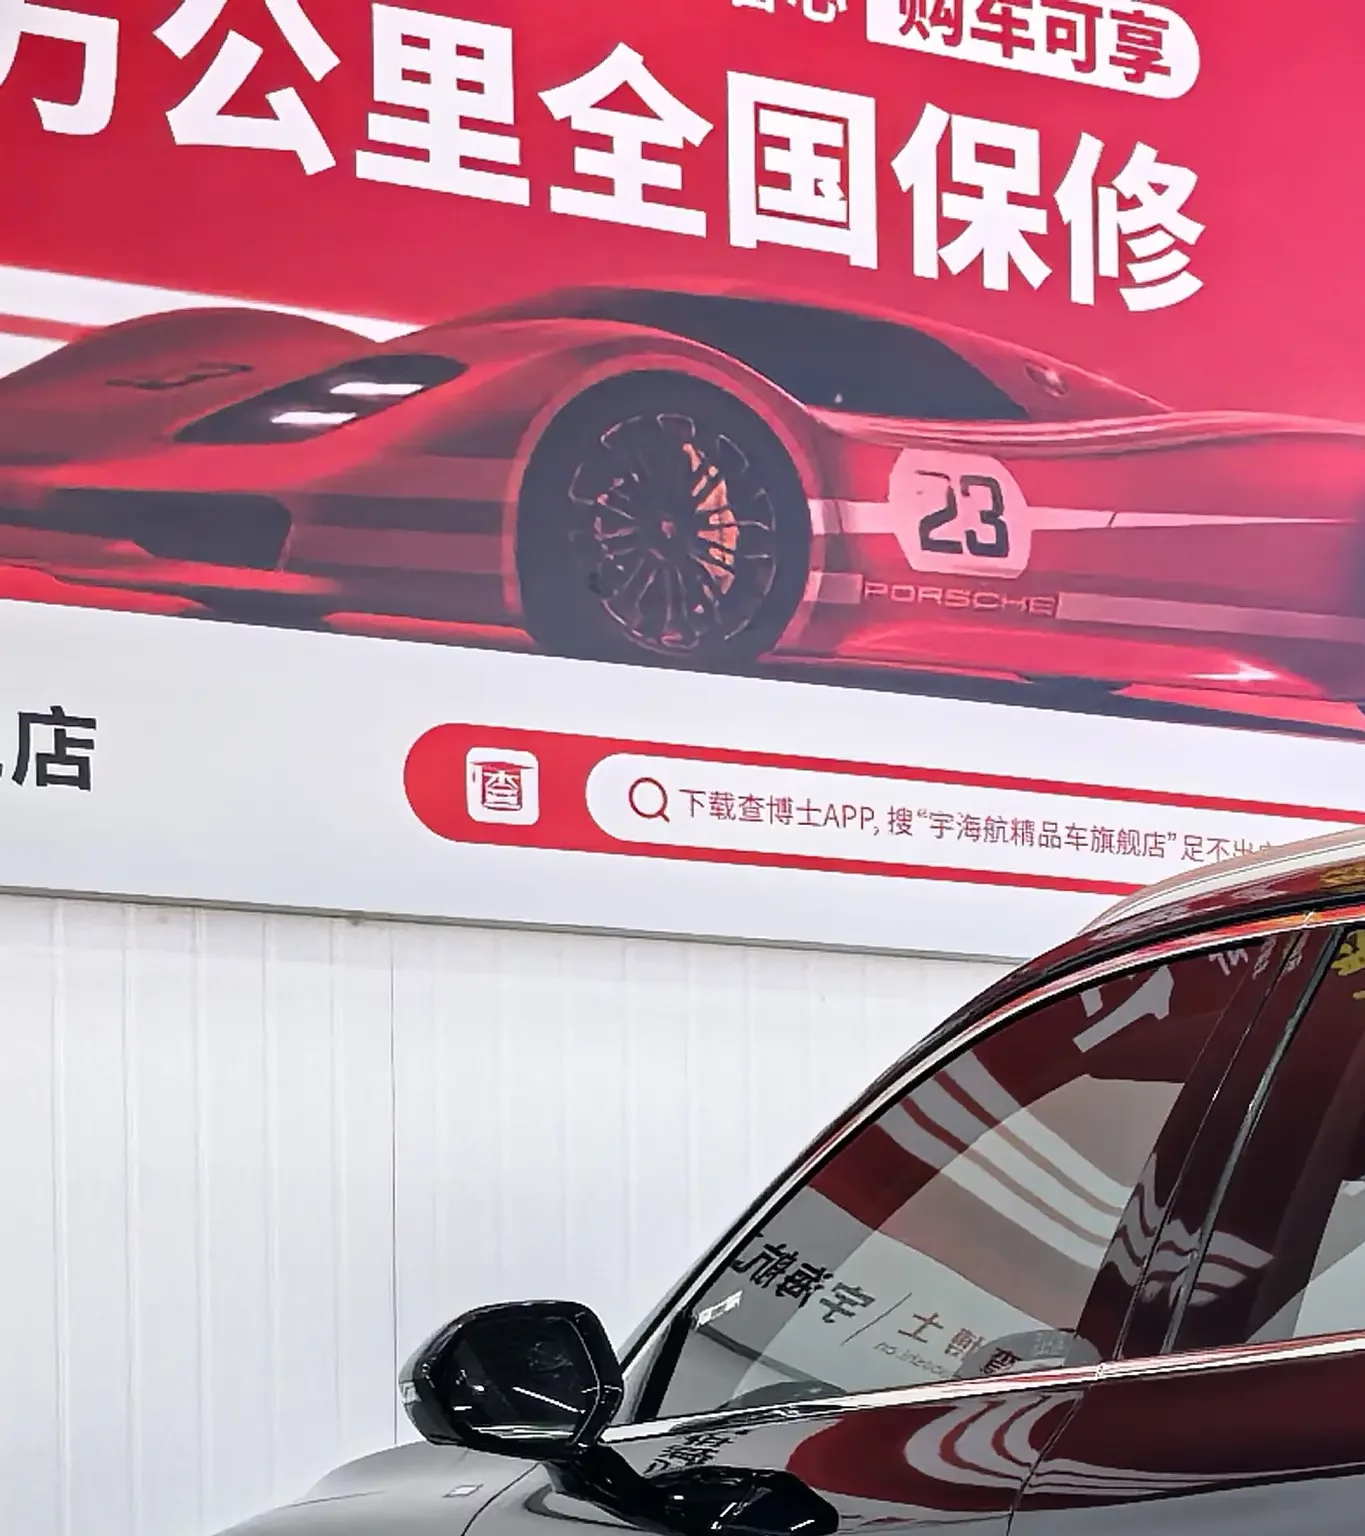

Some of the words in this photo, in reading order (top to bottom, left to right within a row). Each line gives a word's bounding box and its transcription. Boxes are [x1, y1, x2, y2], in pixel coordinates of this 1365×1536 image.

[898, 0, 1171, 84] 购车可享
[914, 470, 1010, 558] 23
[864, 581, 1056, 617] PORSCHE
[0, 706, 97, 791] 店
